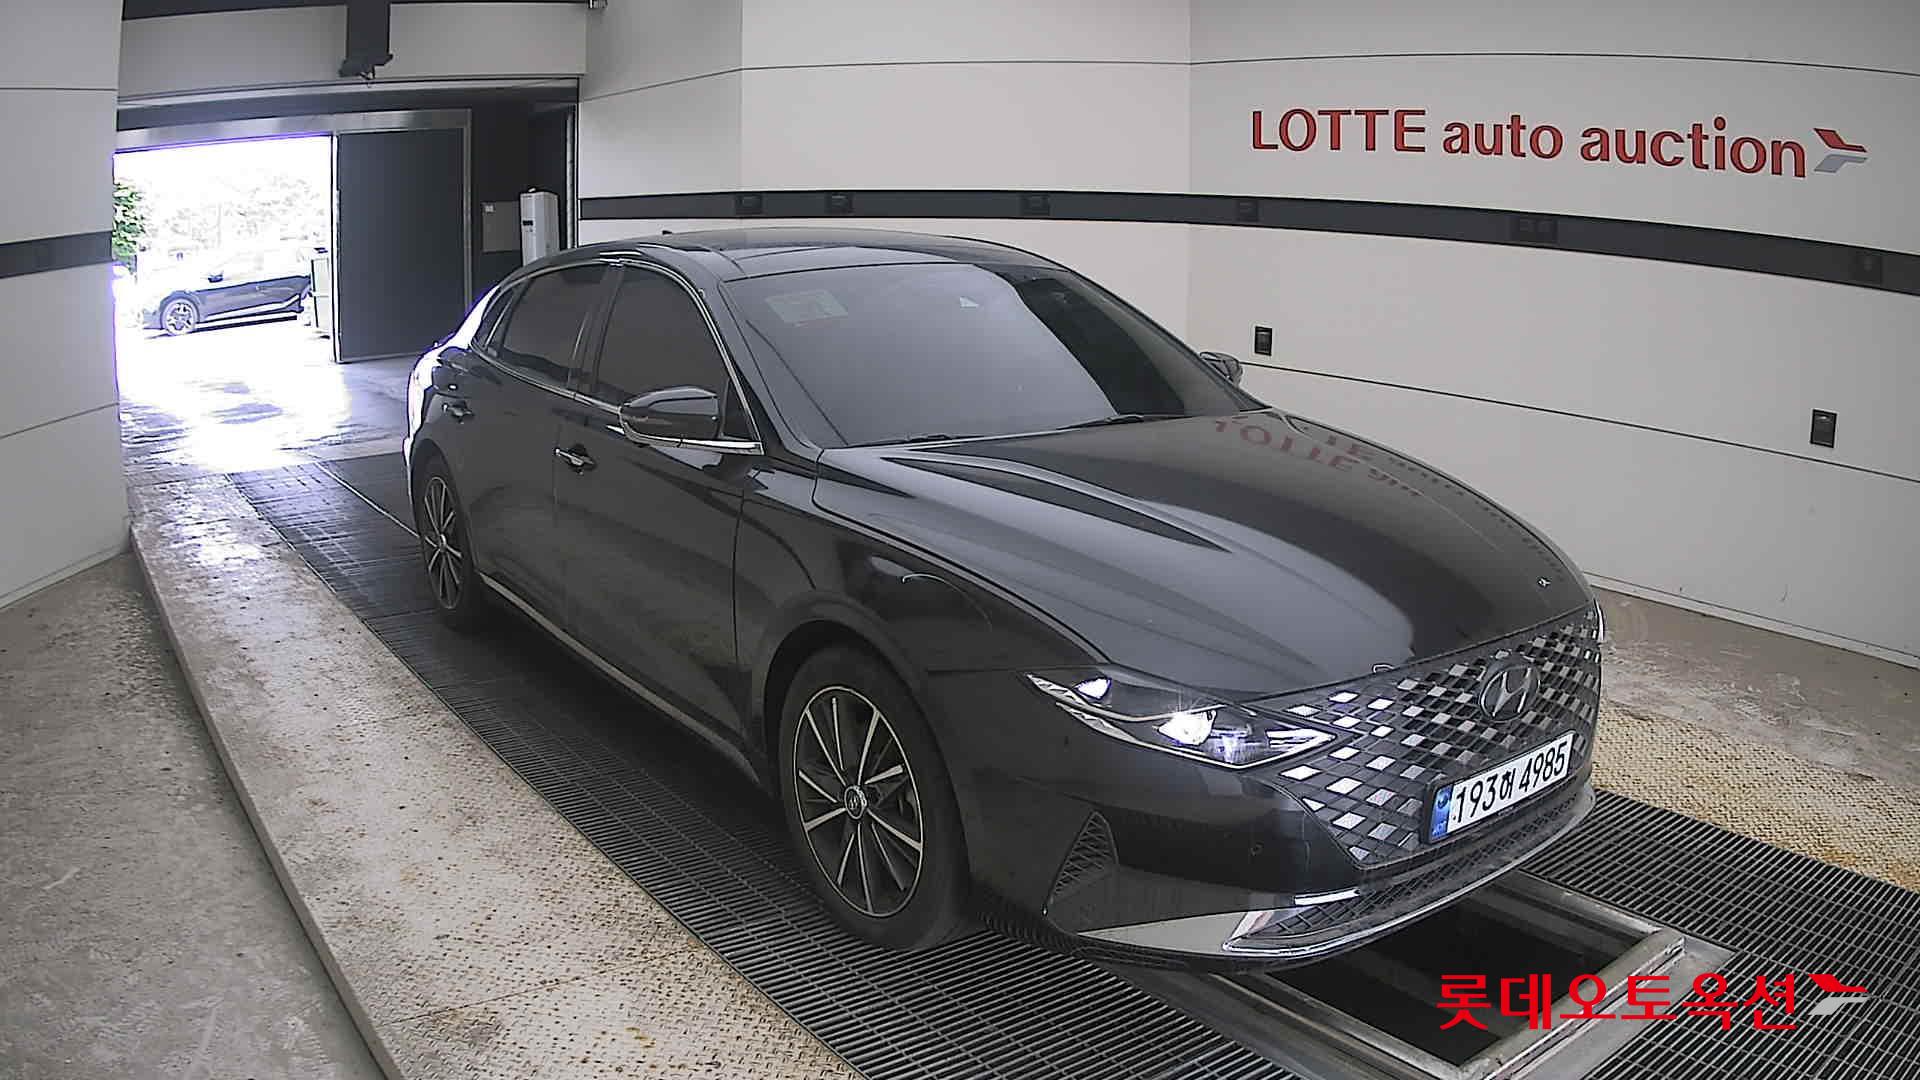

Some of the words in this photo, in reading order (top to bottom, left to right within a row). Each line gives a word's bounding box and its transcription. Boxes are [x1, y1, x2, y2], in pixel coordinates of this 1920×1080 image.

[1251, 108, 1427, 153] LOTTE
[1442, 114, 1564, 160] auto
[1580, 116, 1807, 179] auction
[1456, 768, 1516, 823] 193허
[1519, 741, 1568, 792] 4985
